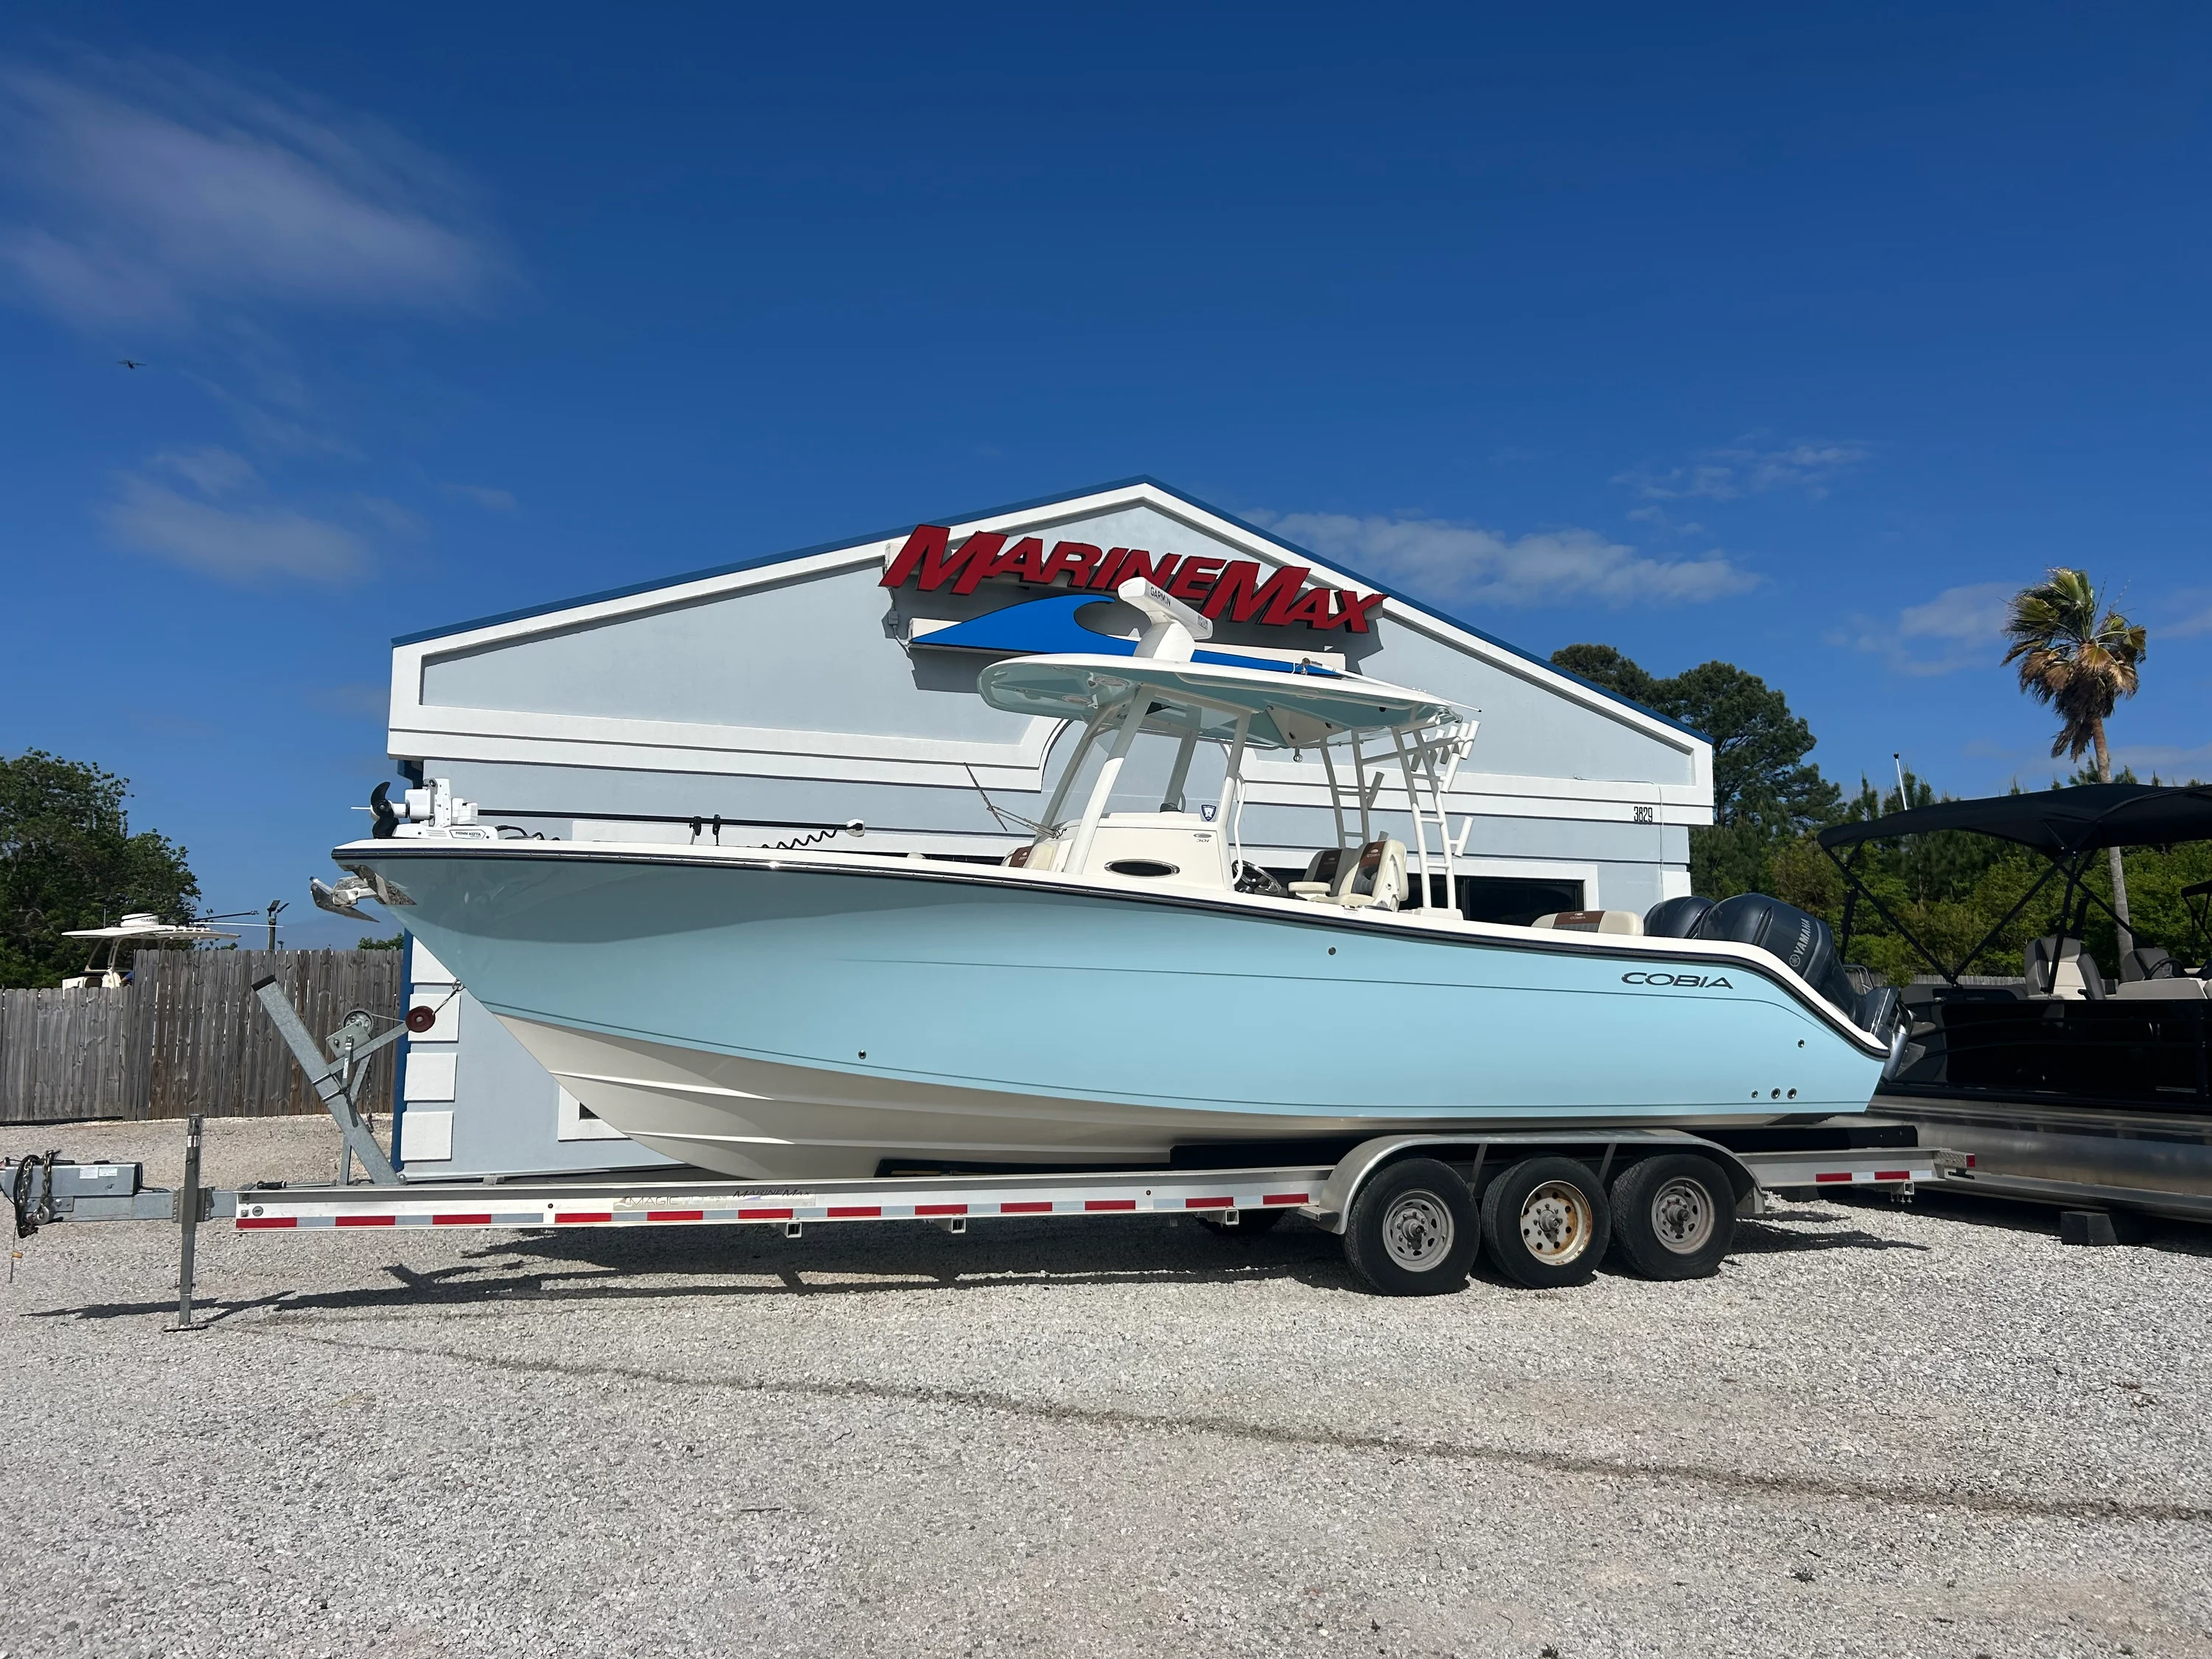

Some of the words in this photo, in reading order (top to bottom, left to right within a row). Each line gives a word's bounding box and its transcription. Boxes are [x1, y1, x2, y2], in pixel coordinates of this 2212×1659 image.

[1150, 586, 1171, 606] GARMIN
[1633, 806, 1653, 822] 3829
[1793, 917, 1811, 956] YAMAHA
[1621, 972, 1733, 990] COBIA
[629, 1196, 679, 1206] MAGIC
